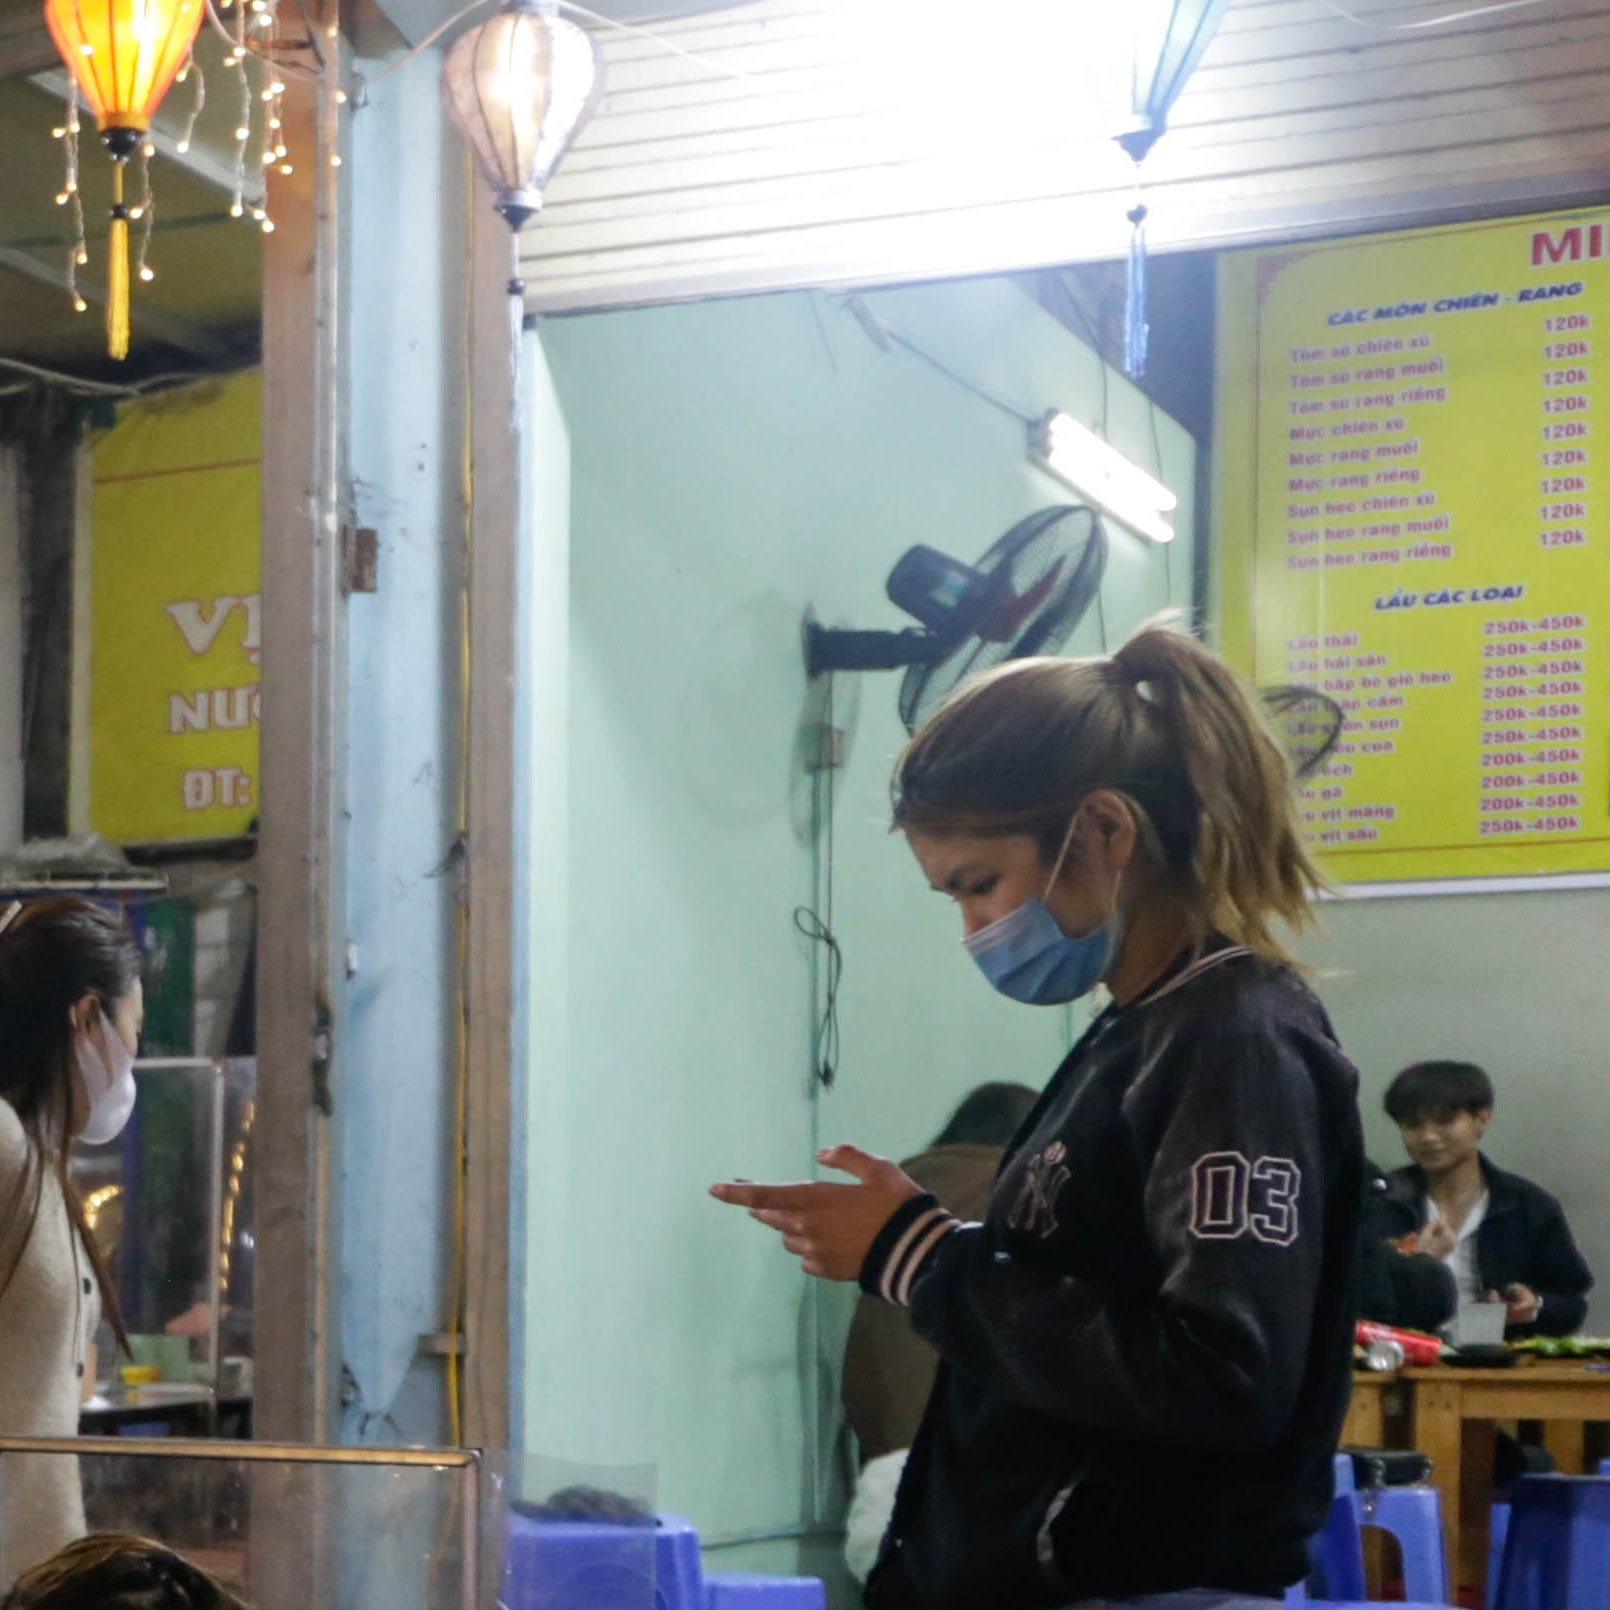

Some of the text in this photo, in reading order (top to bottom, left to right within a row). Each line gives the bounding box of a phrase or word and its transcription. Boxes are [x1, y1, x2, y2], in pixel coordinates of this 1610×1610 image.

[1531, 223, 1610, 266] MI
[1518, 280, 1585, 303] RANG
[1545, 314, 1589, 333] 120k
[1545, 341, 1589, 360] 120k
[1544, 369, 1588, 387] 120k
[1544, 396, 1588, 414] 120k
[1543, 422, 1588, 440] 120k
[1542, 450, 1587, 467] 120k
[1541, 477, 1586, 495] 120k
[1541, 503, 1585, 520] 120k
[1541, 530, 1585, 548] 120k
[164, 594, 262, 664] VỊ
[1484, 615, 1584, 635] 250k-450k
[1483, 638, 1583, 657] 250k-450k
[1483, 660, 1582, 680] 250k-450k
[1483, 681, 1581, 700] 250k-450k
[1482, 703, 1580, 723] 250k-450k
[1482, 726, 1580, 745] 250k-450k
[1482, 748, 1580, 768] 200k-450k
[183, 766, 252, 809] ĐT:
[1481, 771, 1580, 790] 200k-450k
[1480, 793, 1579, 813] 200k-450k
[1480, 815, 1579, 836] 250k-450k
[1189, 1151, 1302, 1247] 03
